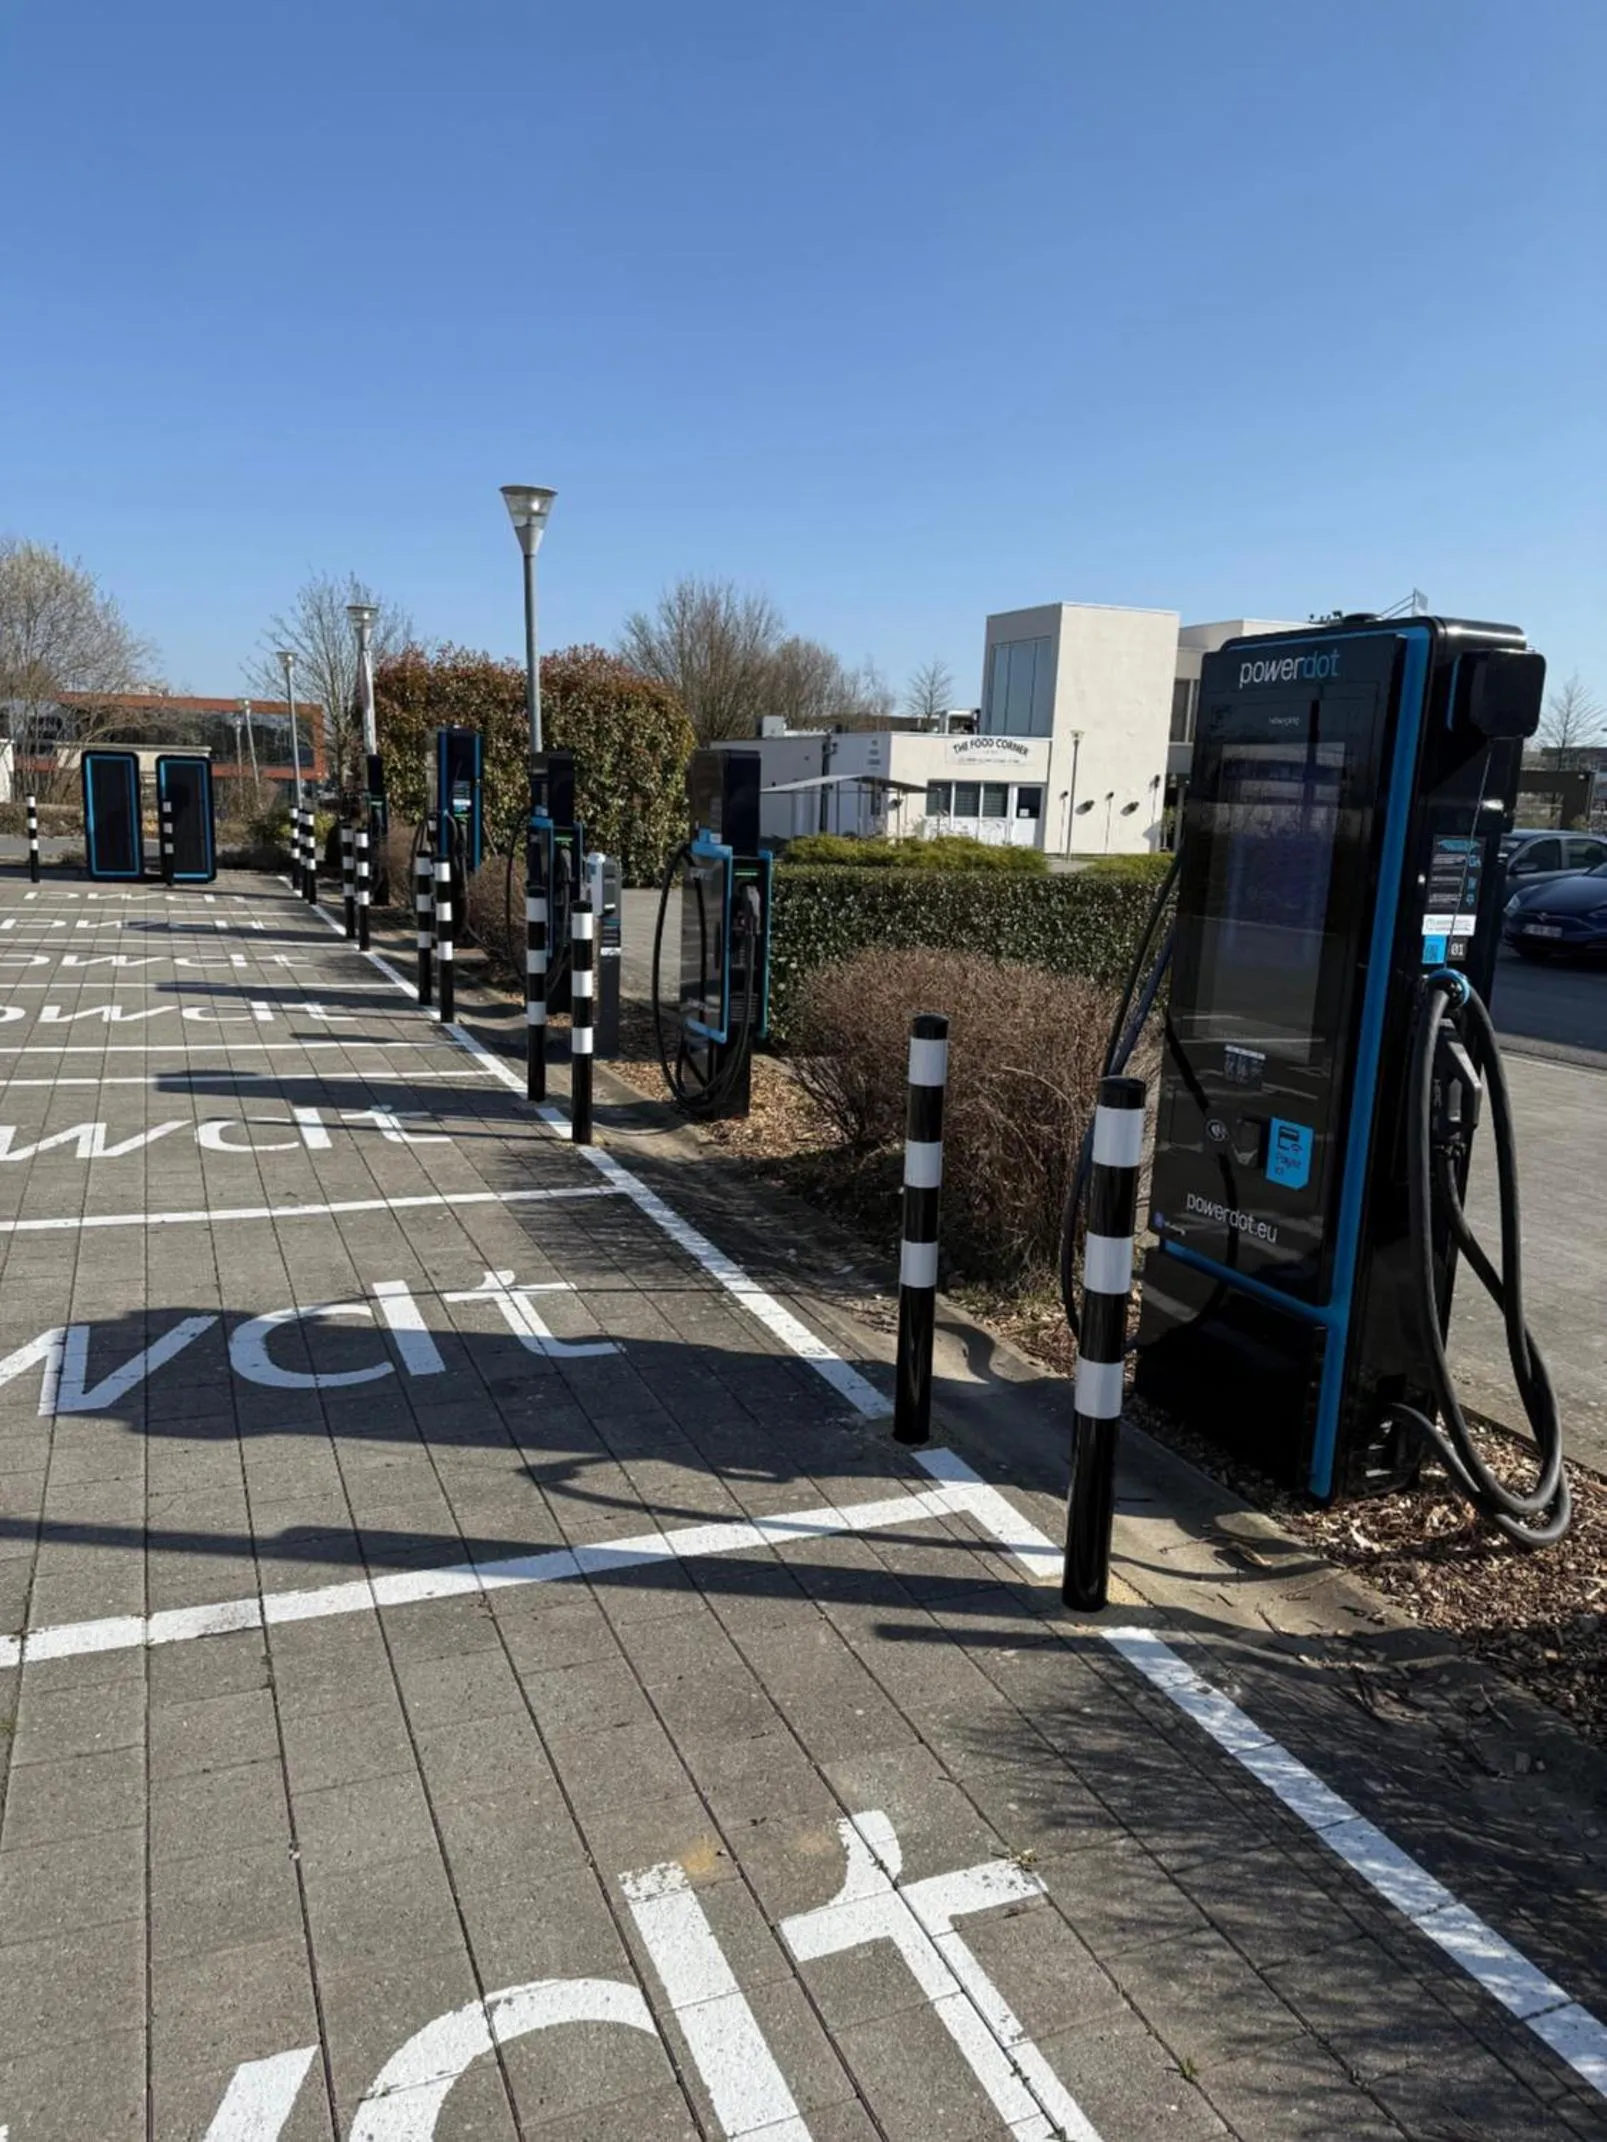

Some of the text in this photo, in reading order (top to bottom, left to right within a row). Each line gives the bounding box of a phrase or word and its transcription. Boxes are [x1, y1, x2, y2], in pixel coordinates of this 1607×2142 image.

[1239, 648, 1340, 690] powerdot
[953, 738, 1029, 757] THE FOOD CORNER
[1186, 1192, 1277, 1243] powerdot.eu
